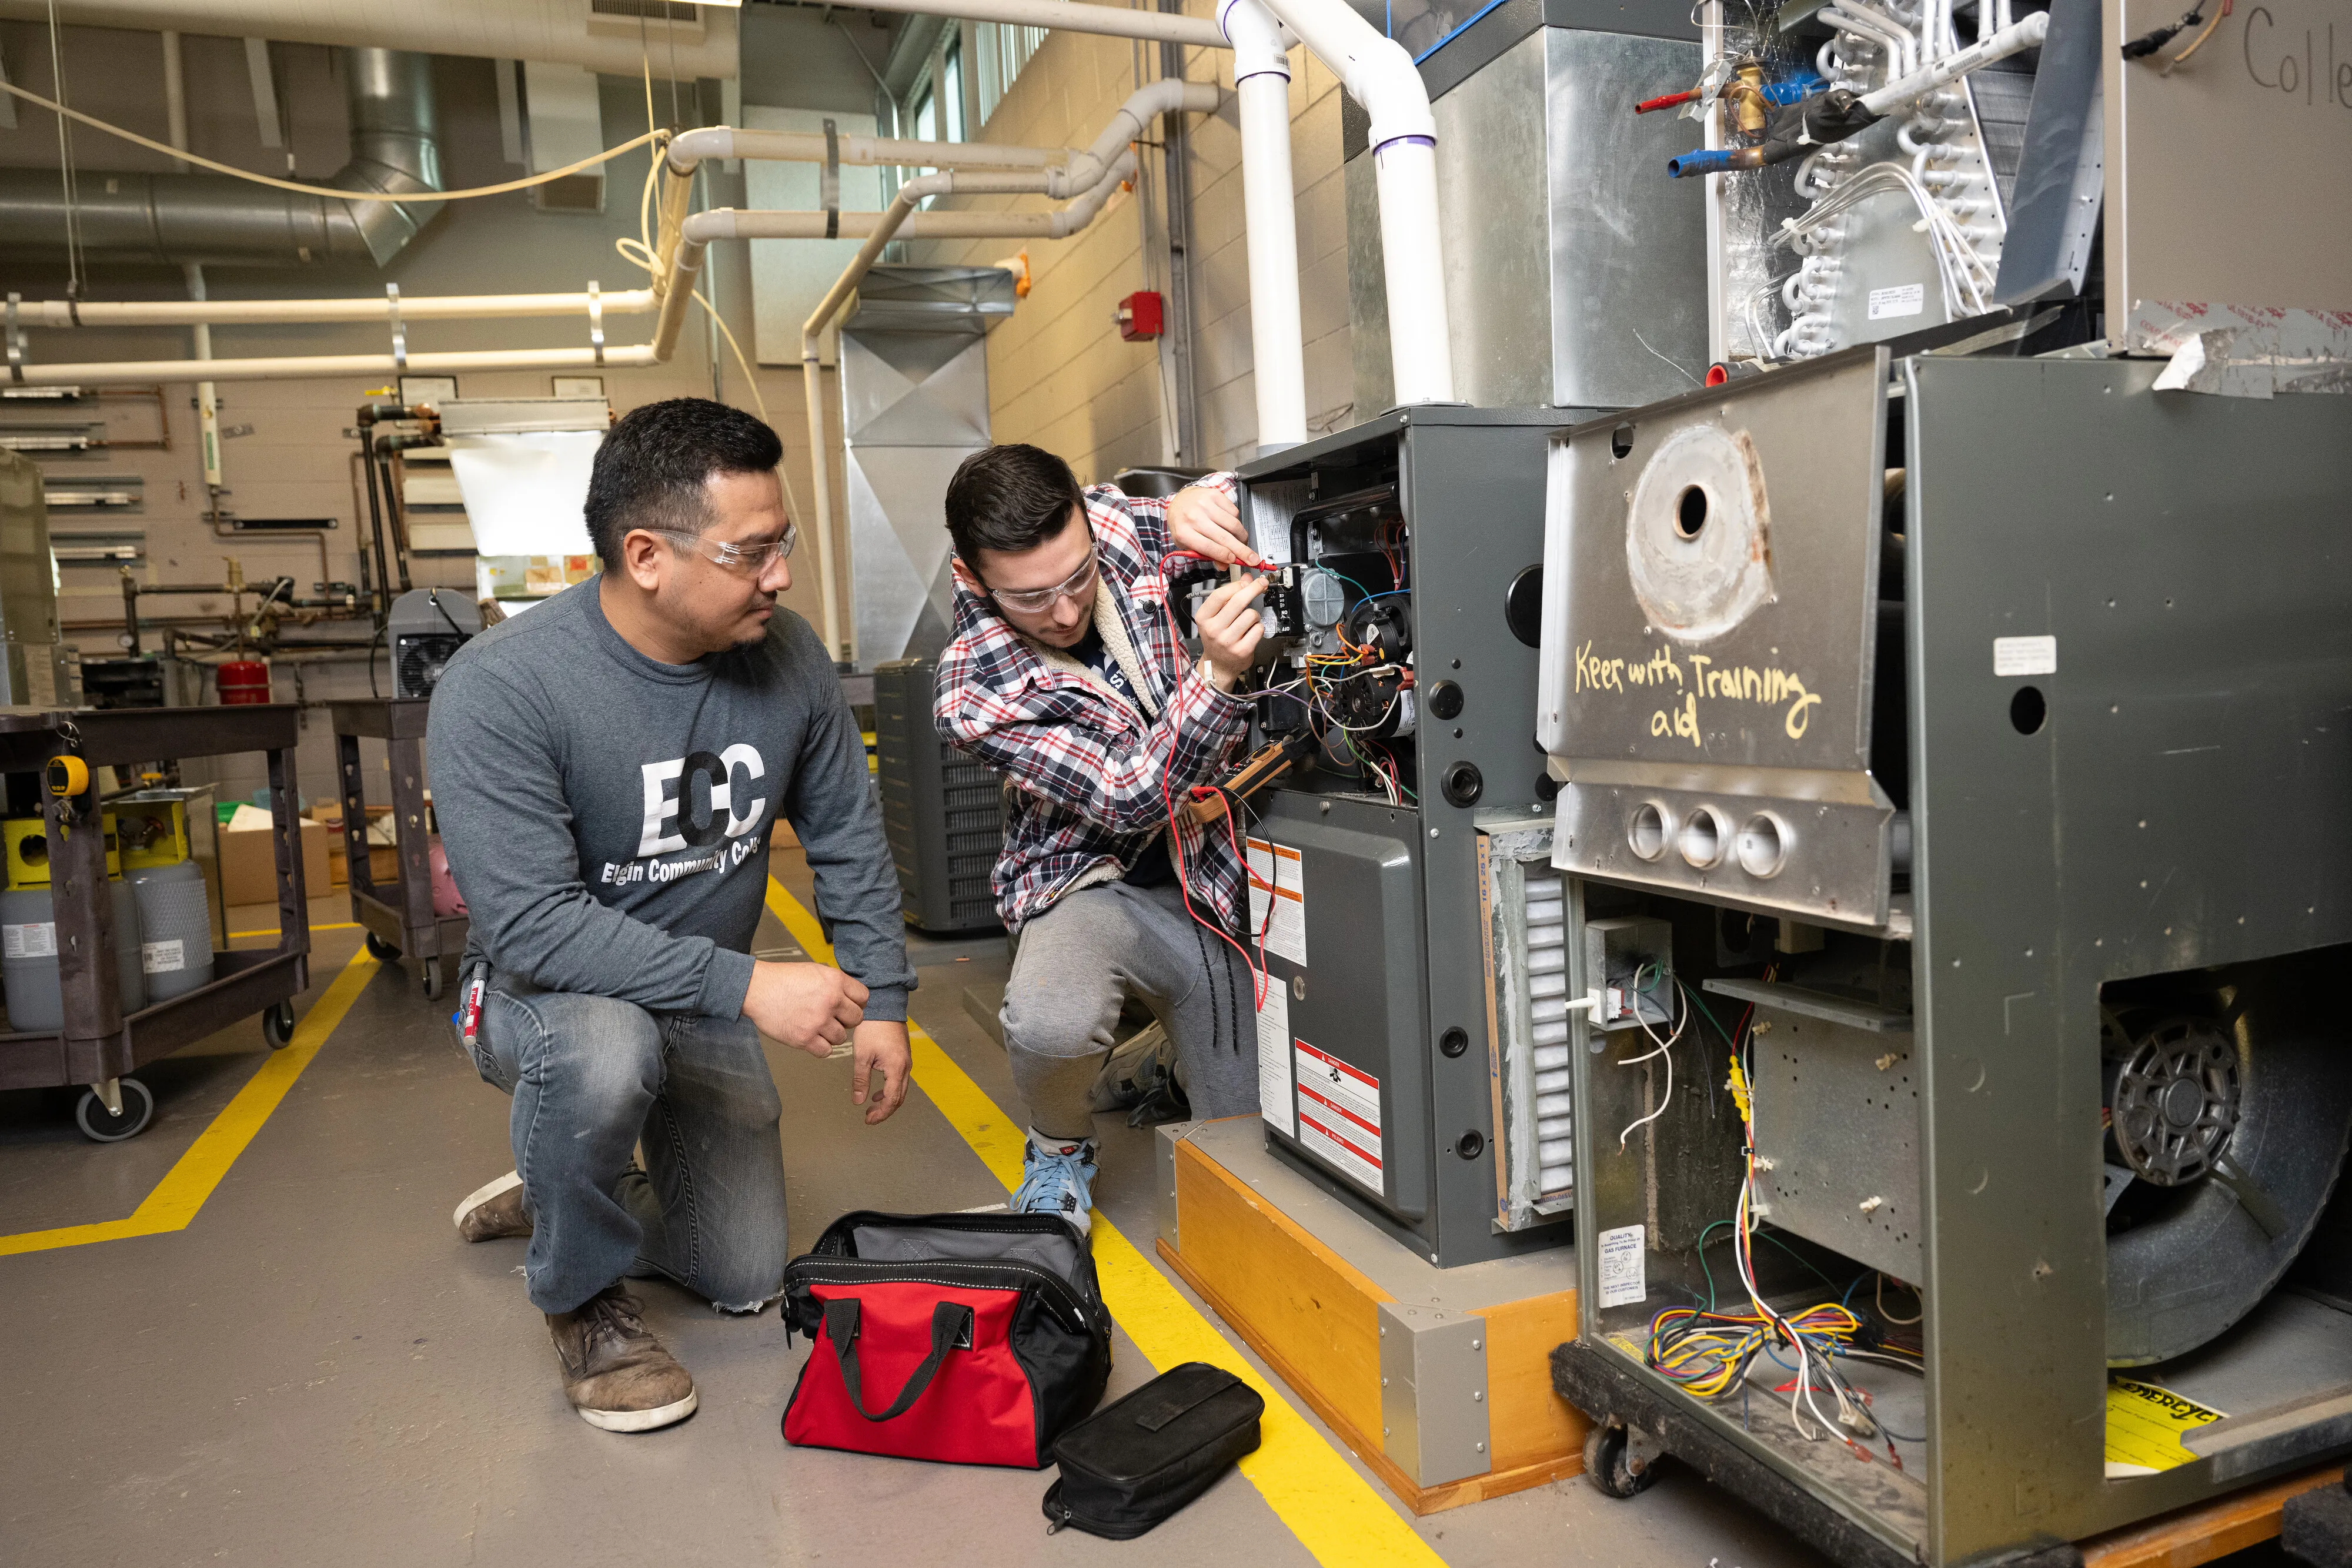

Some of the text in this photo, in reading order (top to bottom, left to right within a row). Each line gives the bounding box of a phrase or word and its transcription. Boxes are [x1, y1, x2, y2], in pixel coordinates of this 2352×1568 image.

[1628, 644, 1683, 687] with
[1689, 654, 1822, 740] Training
[1651, 692, 1700, 747] aid
[637, 743, 766, 857] ECC
[601, 861, 643, 886] Elgin
[649, 849, 727, 882] Community
[1480, 862, 1486, 877] 25
[1482, 890, 1487, 902] 16
[1328, 1058, 1340, 1068] DANGER
[1330, 1103, 1342, 1113] DANGER
[1331, 1133, 1344, 1145] PELIGRO
[1615, 1243, 1637, 1252] FURNACE
